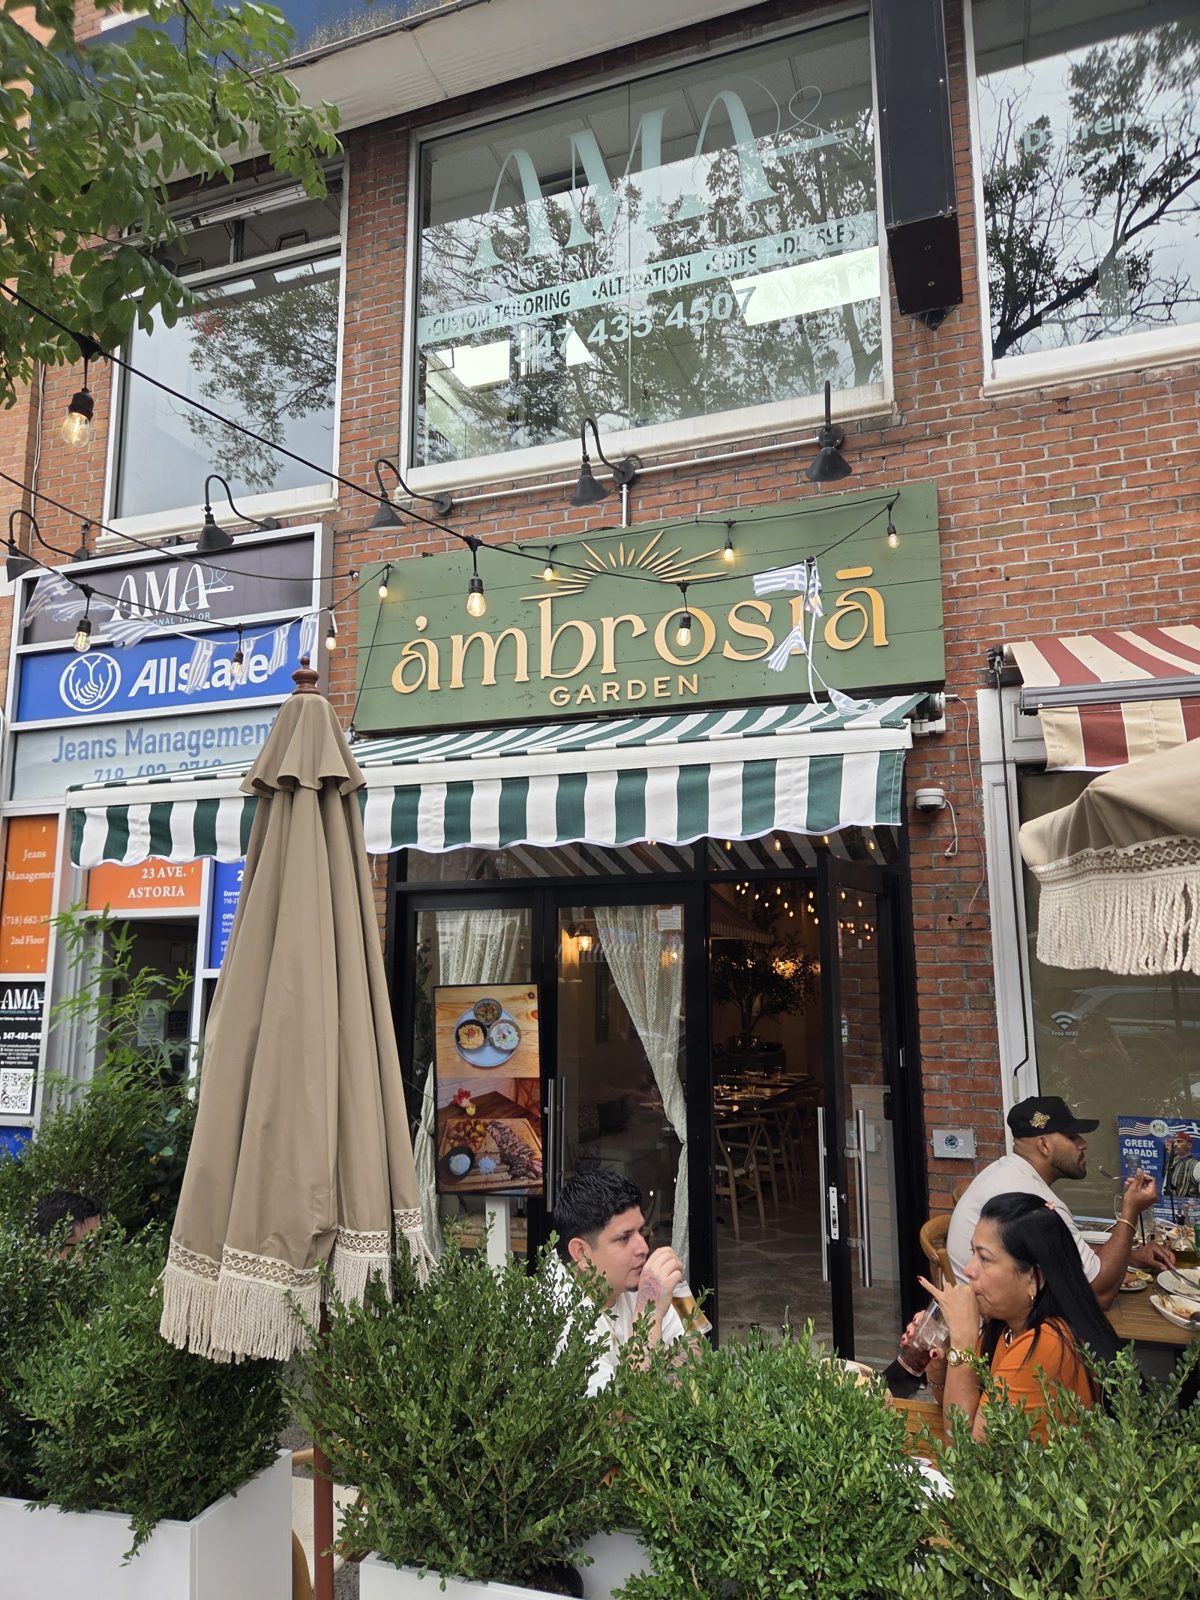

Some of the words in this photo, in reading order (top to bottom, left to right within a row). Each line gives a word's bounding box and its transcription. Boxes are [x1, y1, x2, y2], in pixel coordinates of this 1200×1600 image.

[433, 309, 491, 337] CUSTOM
[494, 289, 571, 323] TAILORING
[587, 312, 653, 347] 435
[664, 286, 757, 329] 4507
[110, 563, 211, 622] AMA
[549, 673, 698, 706] GARDEN
[52, 736, 117, 763] Jeans
[22, 849, 47, 861] Jeans
[142, 868, 155, 879] 23
[157, 866, 187, 878] AVE.
[128, 886, 185, 899] ASTORIA
[1, 988, 40, 1010] AMA
[1122, 1147, 1158, 1158] PARADE
[1124, 1138, 1155, 1148] GREEK
